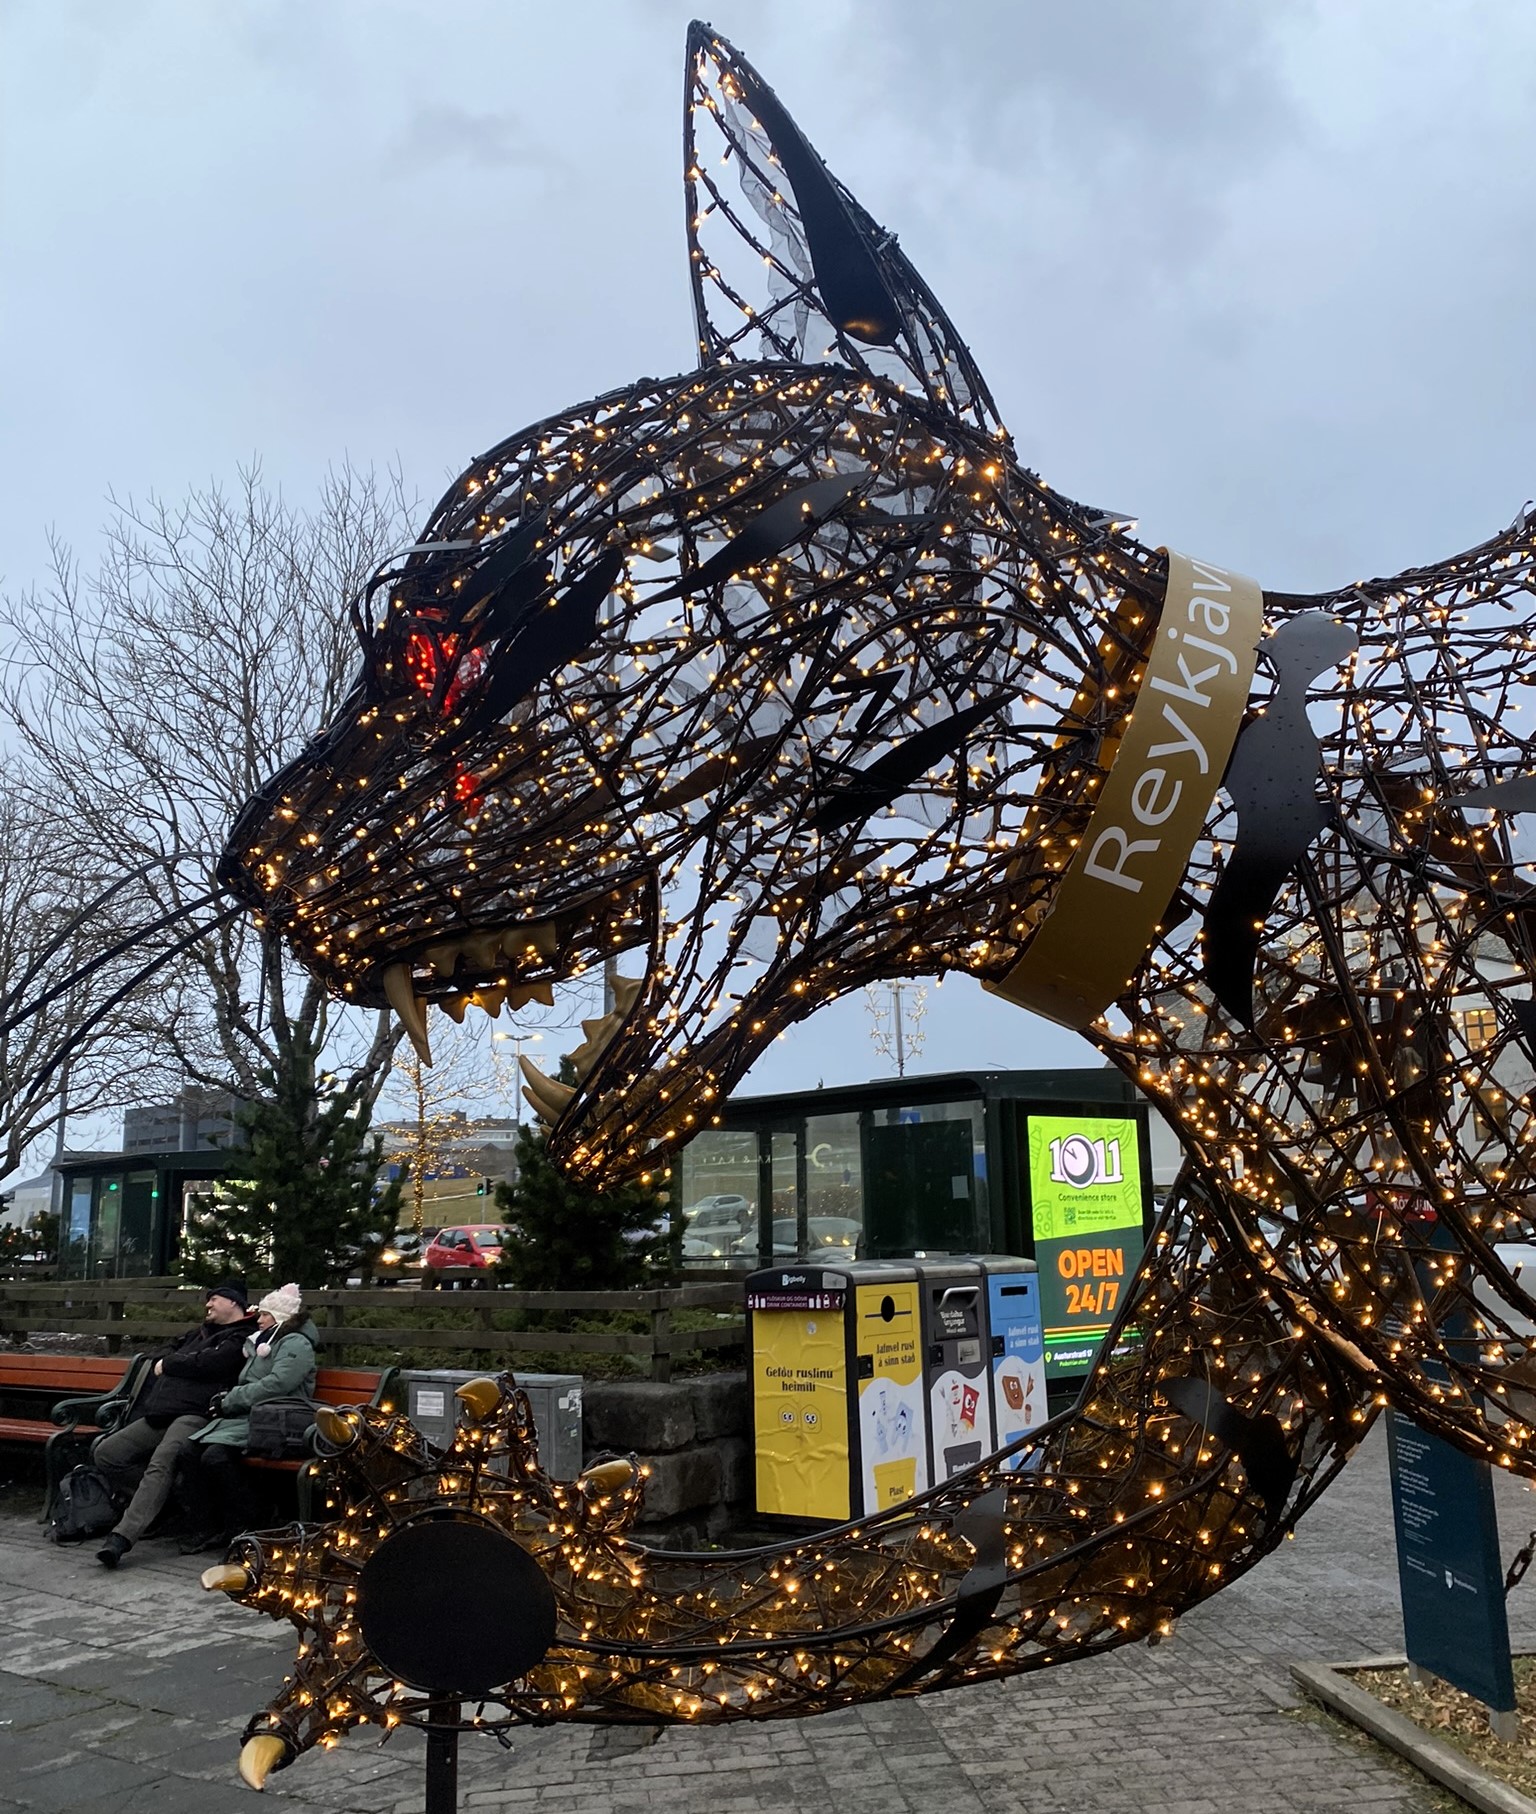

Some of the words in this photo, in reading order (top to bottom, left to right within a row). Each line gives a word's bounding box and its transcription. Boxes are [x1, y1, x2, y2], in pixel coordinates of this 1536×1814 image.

[1058, 1192, 1099, 1202] Convenience
[1100, 1193, 1118, 1202] store
[1058, 1248, 1125, 1279] OPEN
[1065, 1282, 1120, 1315] 24/7
